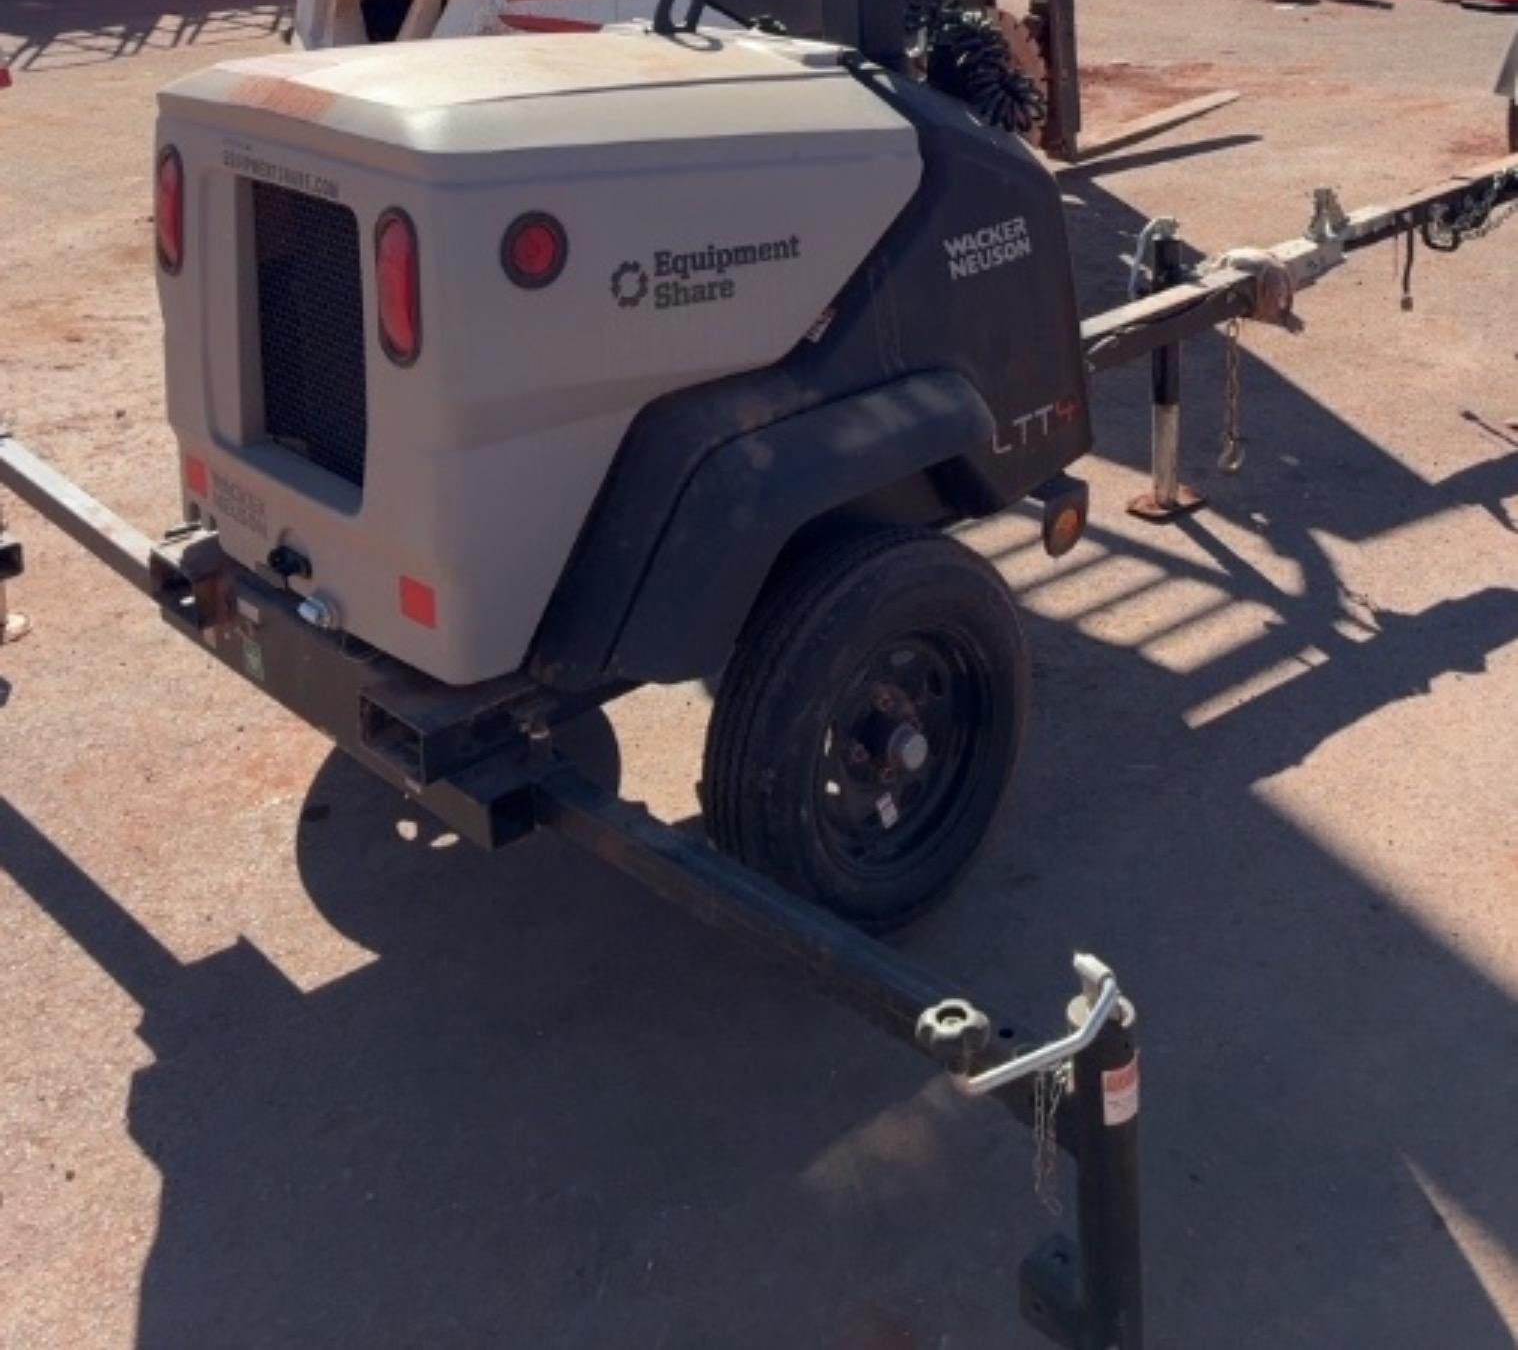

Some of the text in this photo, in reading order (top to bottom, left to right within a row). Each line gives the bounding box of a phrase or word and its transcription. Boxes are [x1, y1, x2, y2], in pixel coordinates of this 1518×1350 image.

[653, 234, 801, 279] Equipment
[943, 217, 1027, 259] WACKER
[949, 236, 1032, 280] NEUSON
[654, 279, 735, 310] Share
[992, 400, 1079, 454] LTT4
